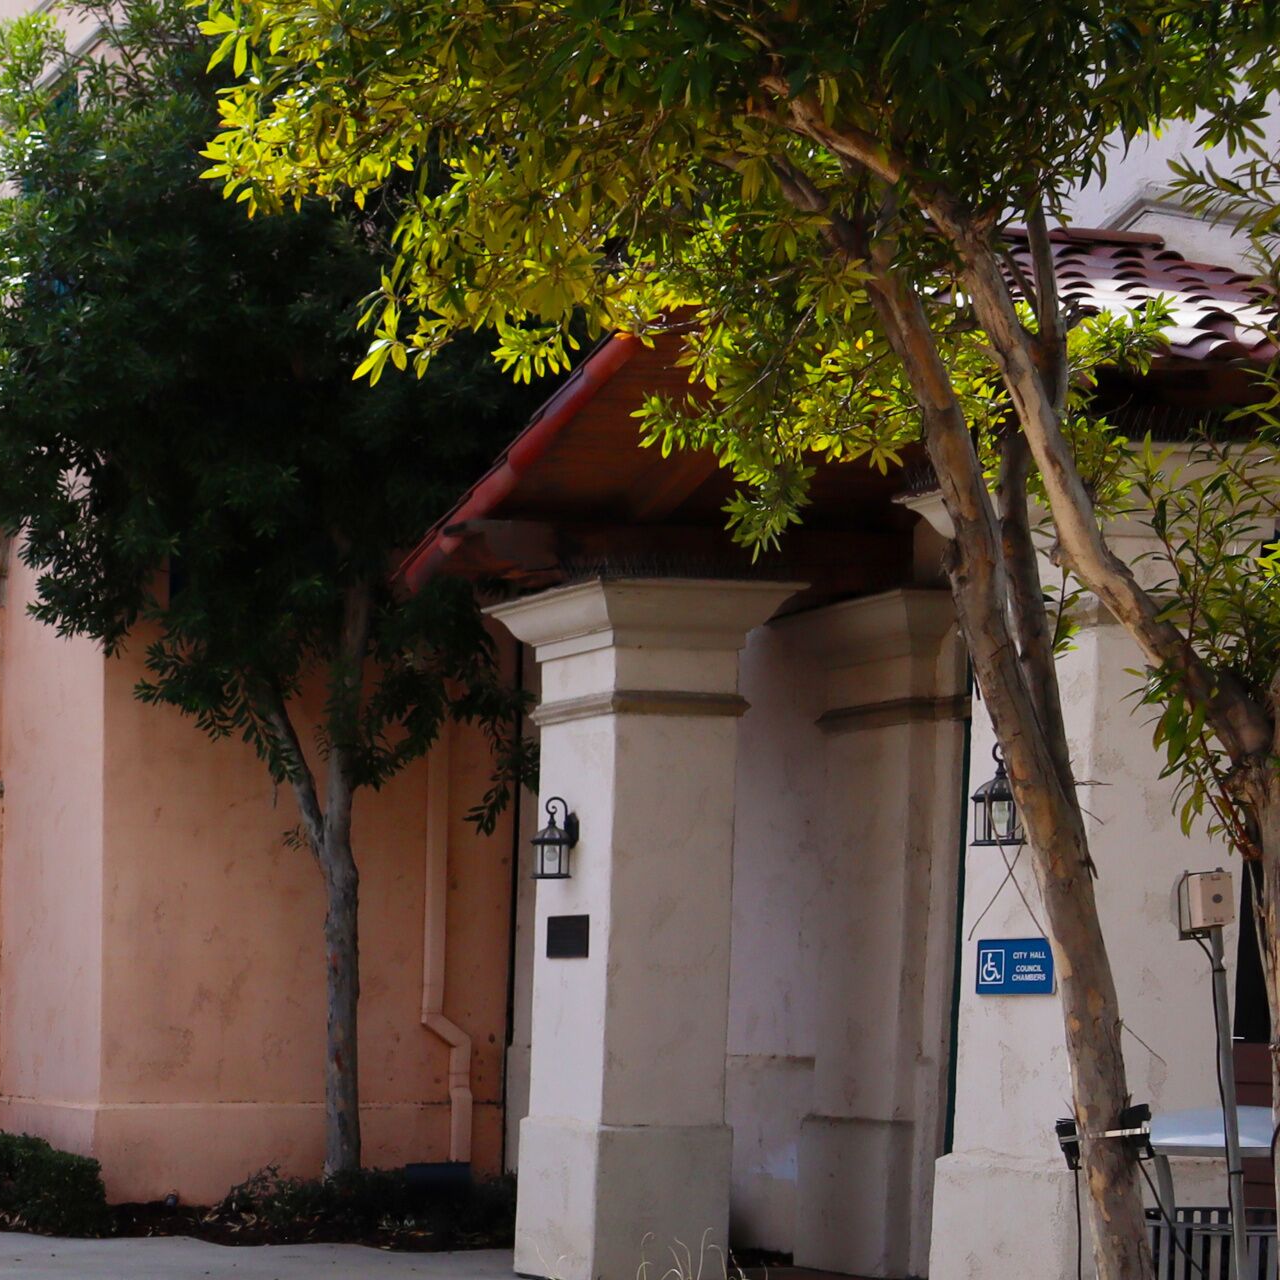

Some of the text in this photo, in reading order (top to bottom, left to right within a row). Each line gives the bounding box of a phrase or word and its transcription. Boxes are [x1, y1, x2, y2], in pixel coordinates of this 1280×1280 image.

[1012, 951, 1046, 959] CITY HALL
[1011, 973, 1046, 981] CHAMBERS
